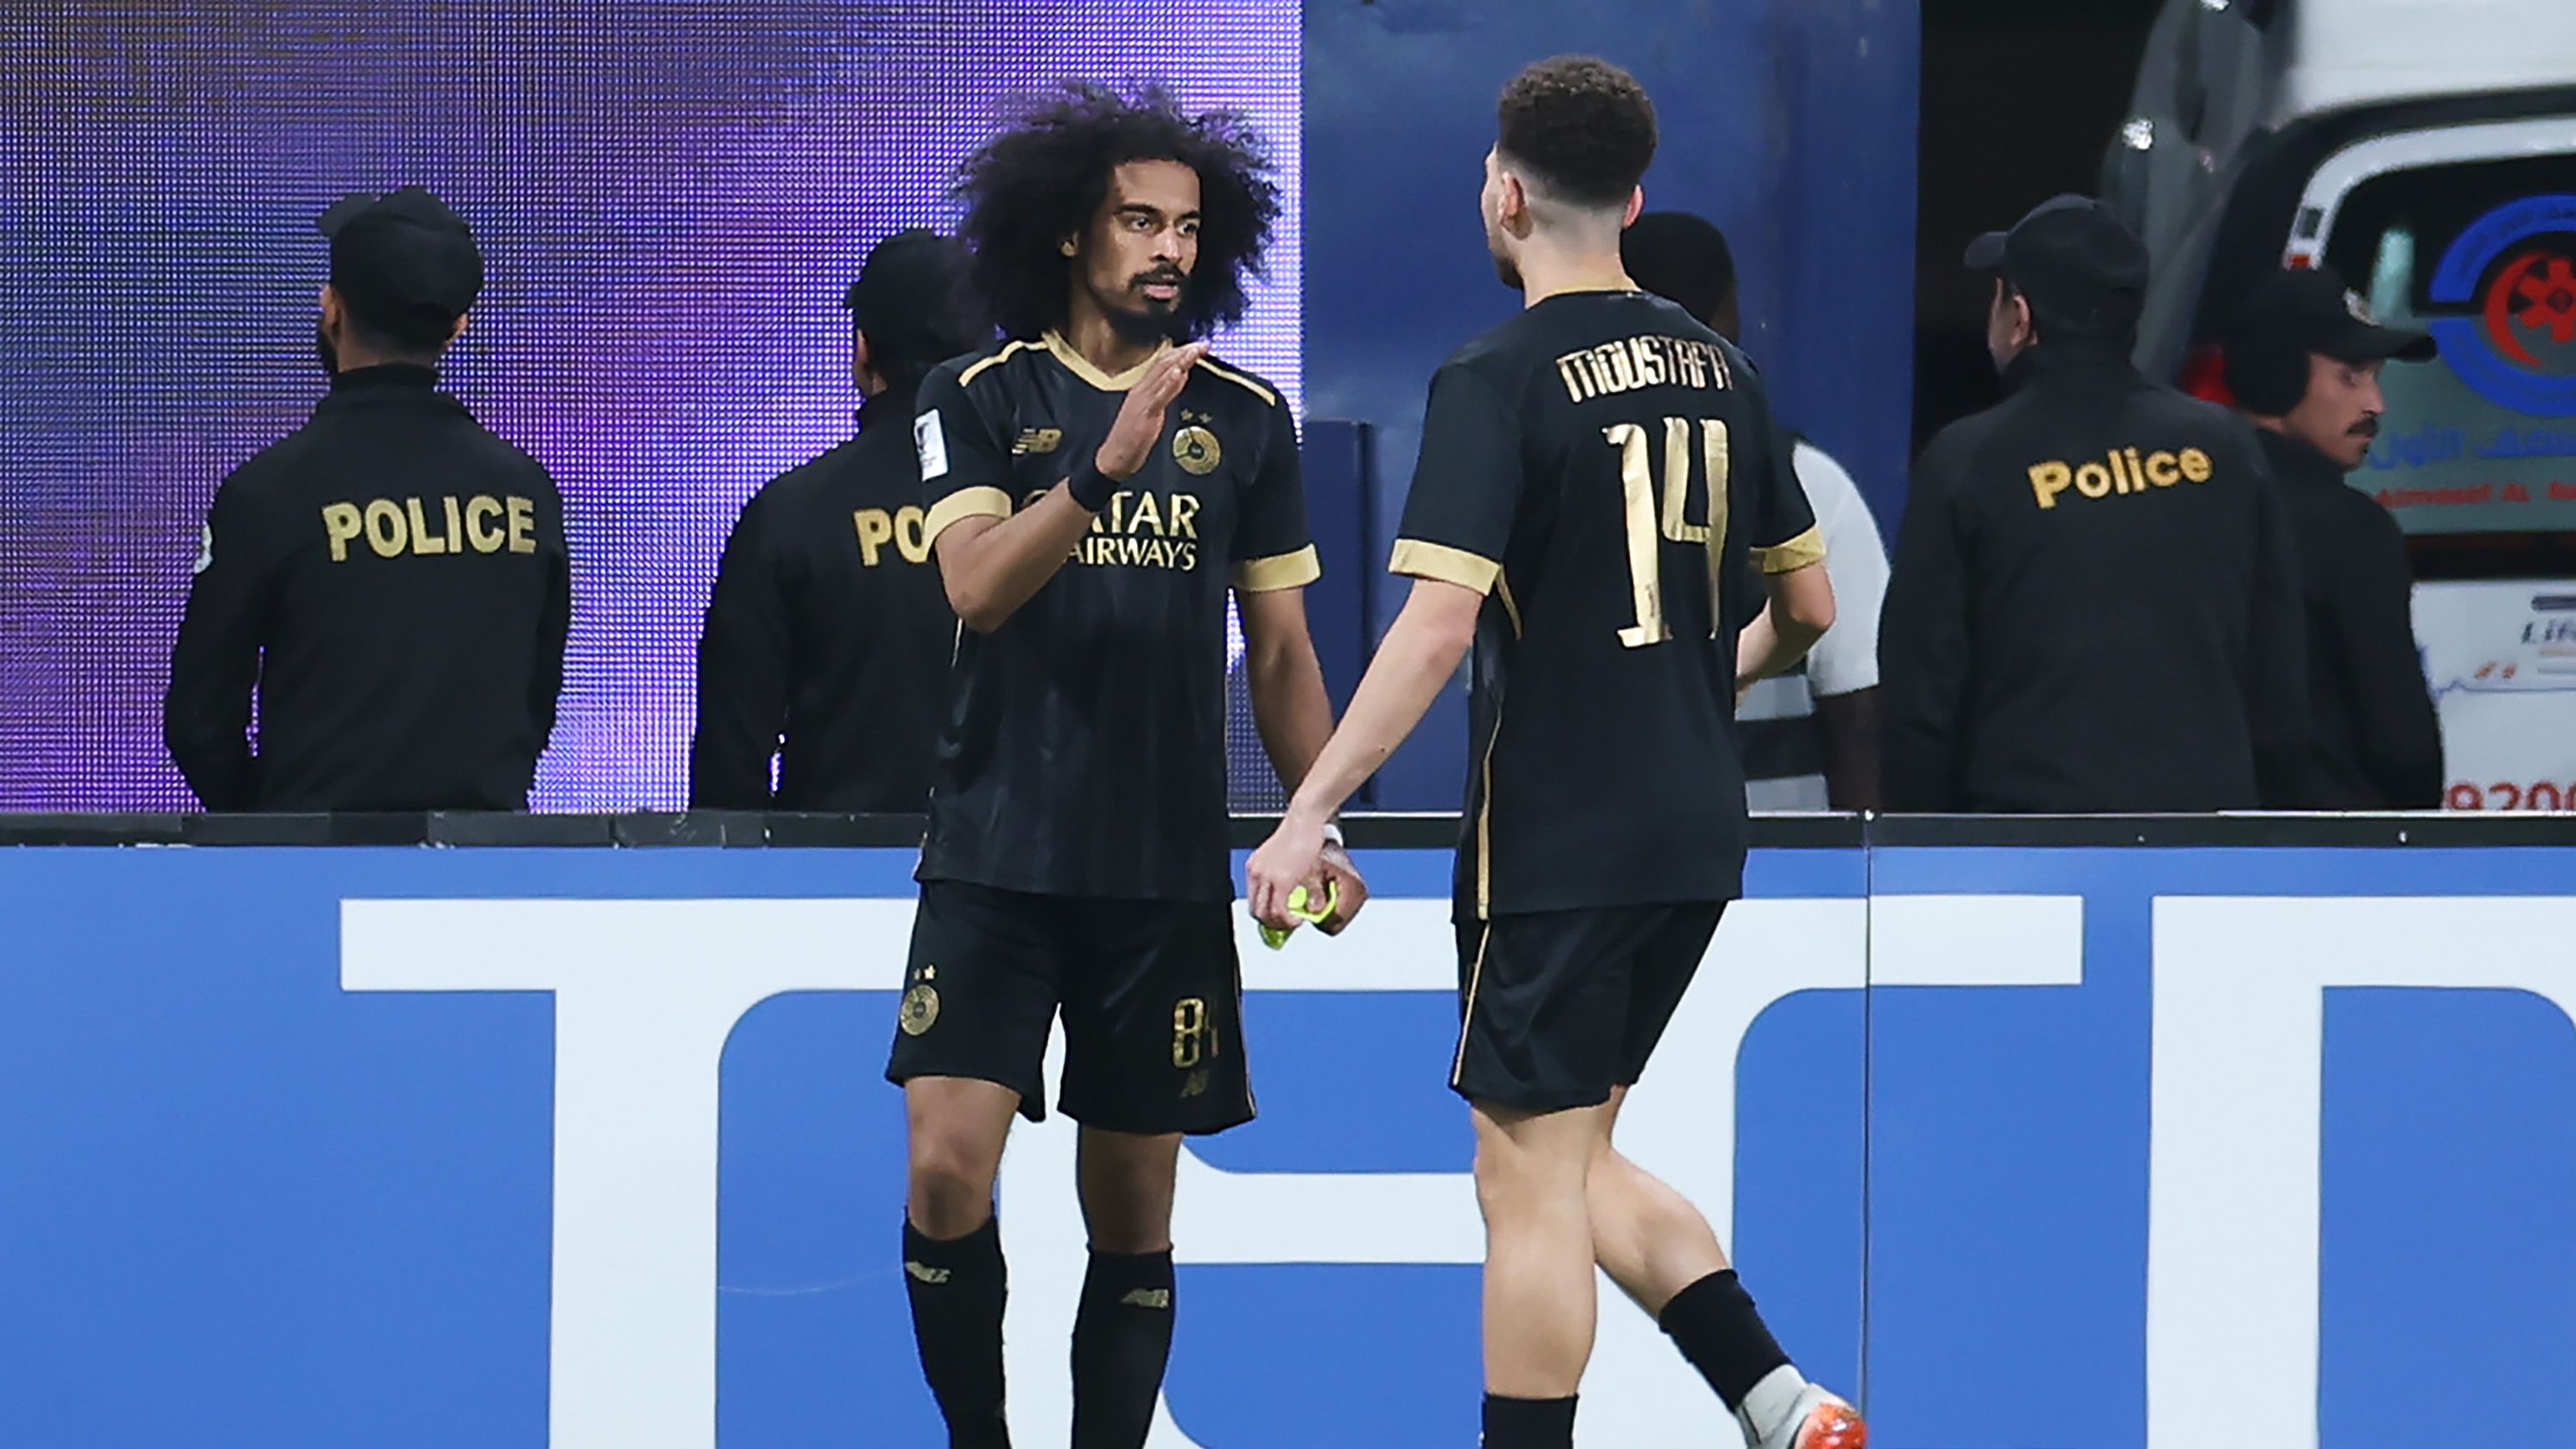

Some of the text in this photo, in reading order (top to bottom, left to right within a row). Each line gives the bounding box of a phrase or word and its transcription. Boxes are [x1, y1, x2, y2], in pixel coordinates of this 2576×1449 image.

[2027, 446, 2213, 508] Police
[321, 495, 537, 562] POLICE
[1067, 537, 1198, 571] AIRWAYS
[1601, 416, 1728, 647] 14
